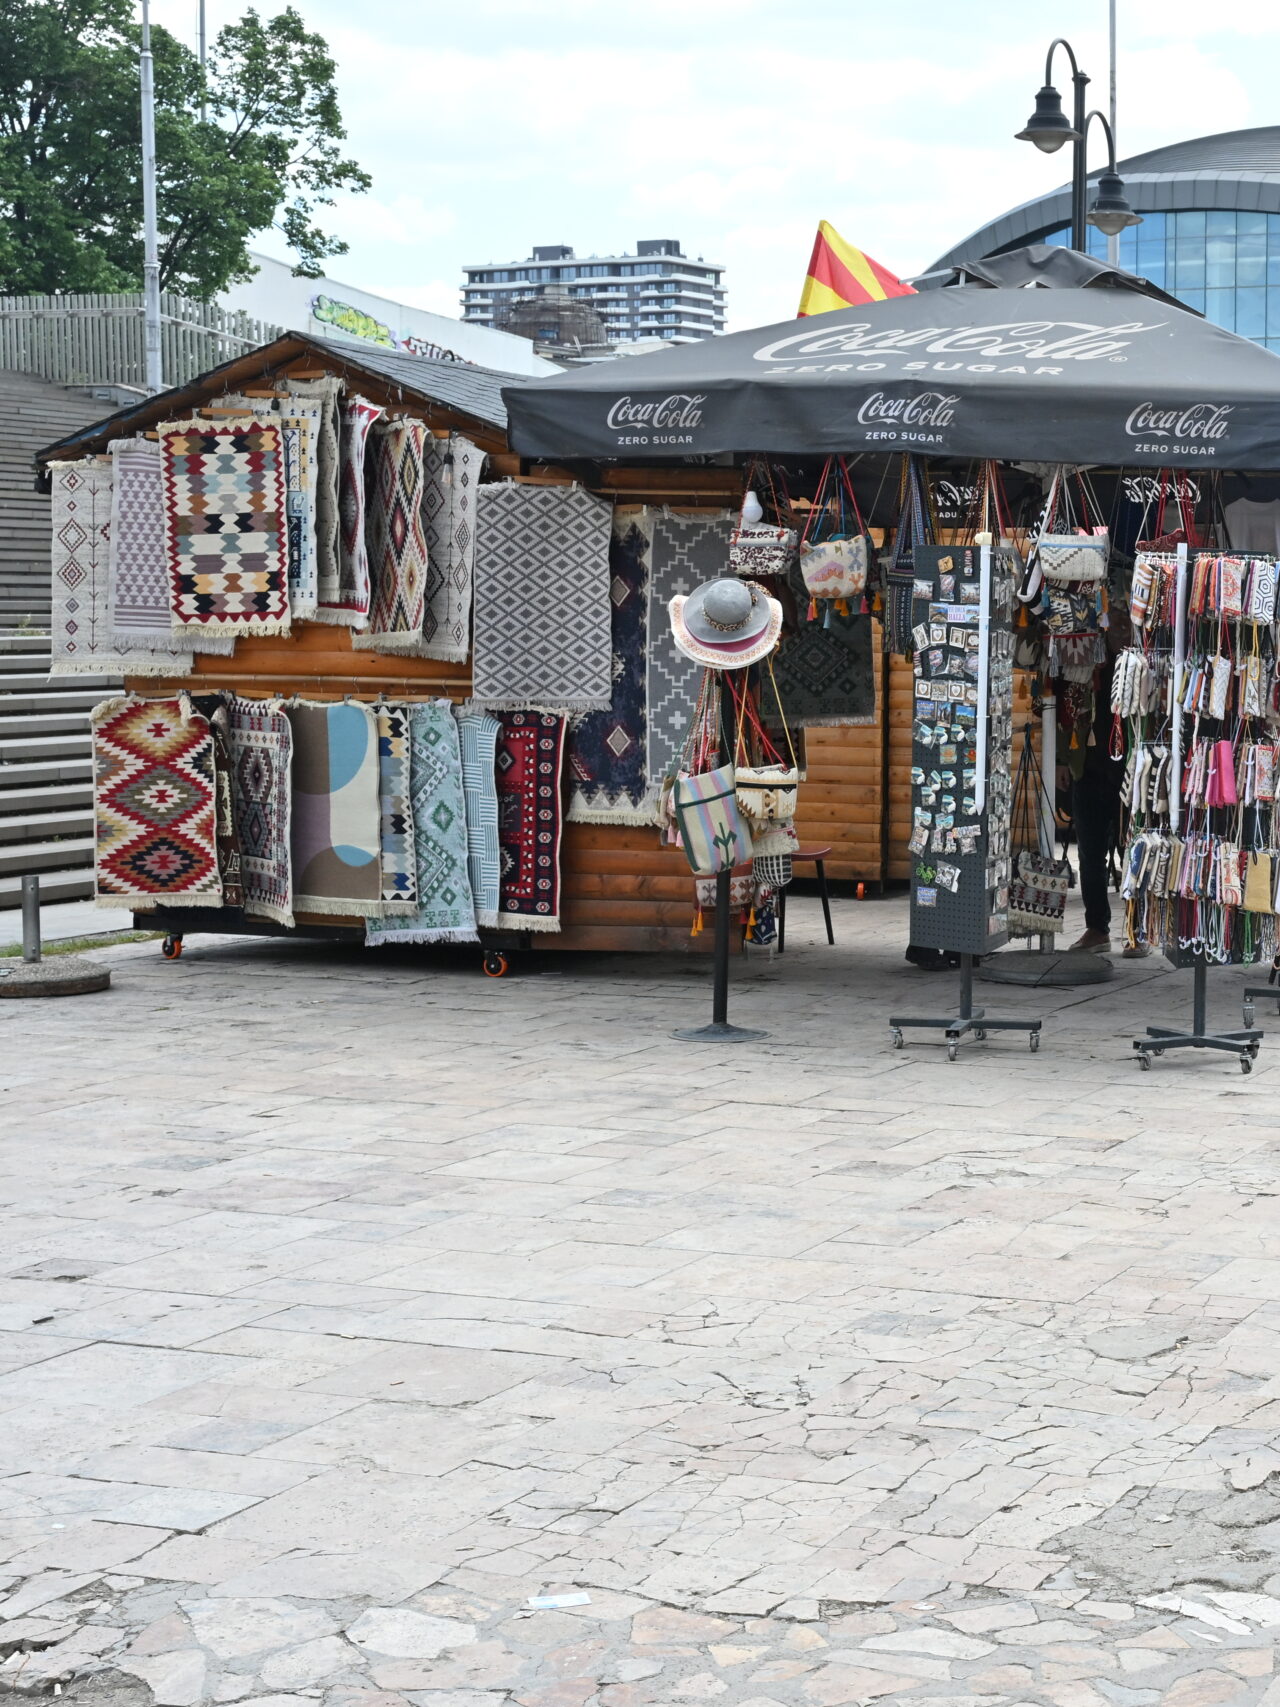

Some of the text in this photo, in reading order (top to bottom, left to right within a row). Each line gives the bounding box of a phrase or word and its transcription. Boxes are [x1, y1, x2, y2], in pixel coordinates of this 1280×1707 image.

[753, 321, 1170, 362] Coca-Cola
[763, 361, 1064, 376] ZERO SUGAR
[606, 395, 708, 430] Coca-Cola
[857, 392, 961, 426] Coca-Cola
[1125, 401, 1236, 439] Coca-Cola
[617, 435, 693, 445] ZERO SUGAR
[865, 431, 943, 443] ZERO SUGAR
[1134, 443, 1216, 455] ZERO SUGAR
